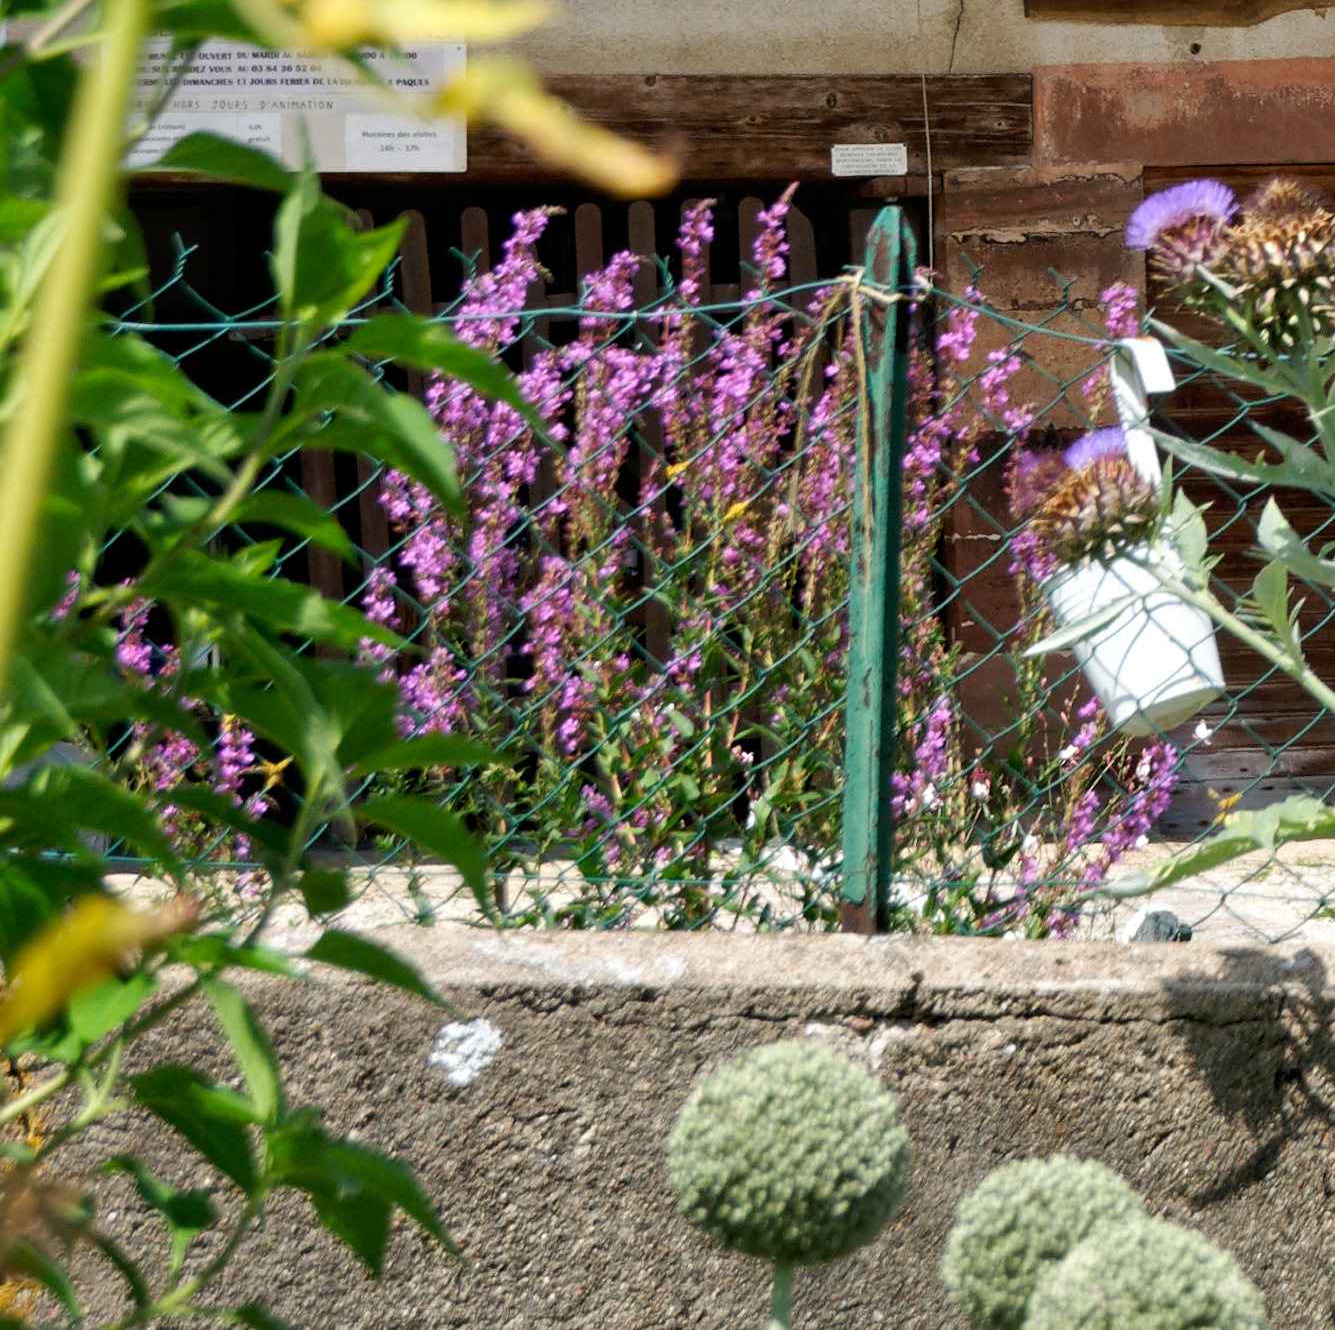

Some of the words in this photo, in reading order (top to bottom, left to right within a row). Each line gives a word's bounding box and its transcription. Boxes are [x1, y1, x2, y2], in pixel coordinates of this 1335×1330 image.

[183, 78, 233, 87] DIMANCHES
[211, 101, 249, 110] JOURS
[257, 100, 334, 110] D'ANIMATION
